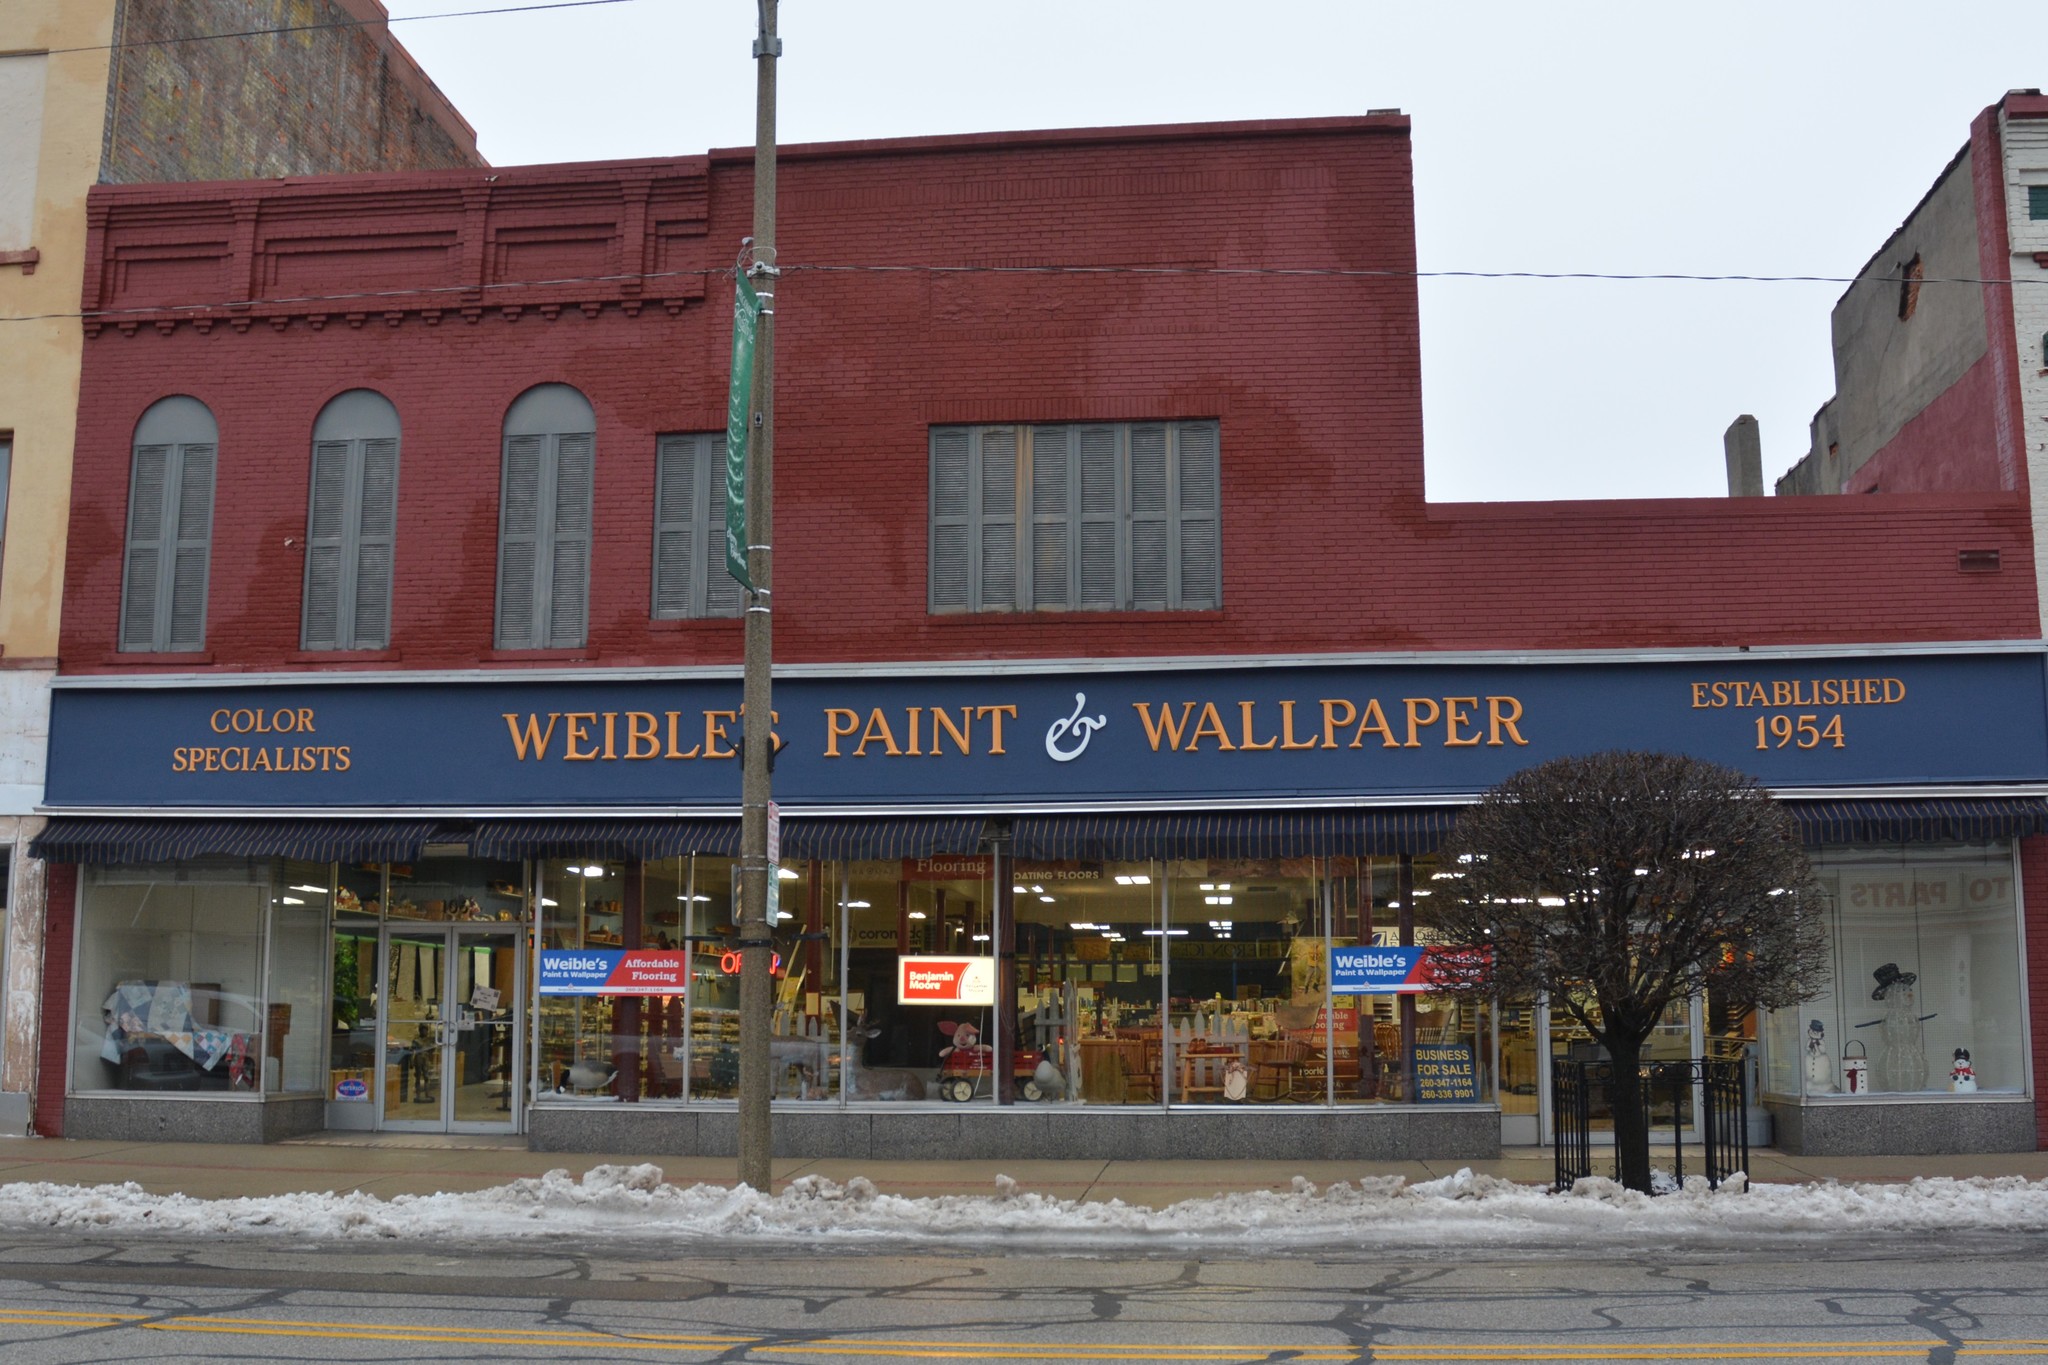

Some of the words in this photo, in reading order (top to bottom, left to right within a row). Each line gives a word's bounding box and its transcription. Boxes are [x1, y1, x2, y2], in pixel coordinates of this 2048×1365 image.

[1690, 678, 1906, 708] ESTABLISHED
[210, 708, 316, 734] COLOR
[823, 704, 1017, 757] PAINT
[1045, 692, 1107, 762] &
[1132, 696, 1529, 752] WALLPAPER
[1755, 714, 1846, 750] 1954
[172, 745, 351, 772] SPECIALISTS
[916, 858, 987, 875] Flooring
[1014, 871, 1053, 880] OATING
[1057, 871, 1099, 880] FLOORS
[543, 957, 608, 971] Weible's
[625, 959, 680, 968] Affordable
[1335, 954, 1407, 968] Weible's
[543, 971, 562, 979] Paint
[570, 971, 608, 979] Wallpaper
[632, 971, 677, 982] Flooring
[909, 971, 955, 982] Benjamin
[1366, 968, 1407, 977] Wallpaper
[909, 980, 941, 990] Moore
[1416, 1050, 1469, 1060] BUSINESS
[1417, 1064, 1440, 1075] FOR
[1441, 1064, 1472, 1075] SALE
[1420, 1078, 1473, 1087] 260-347-1164
